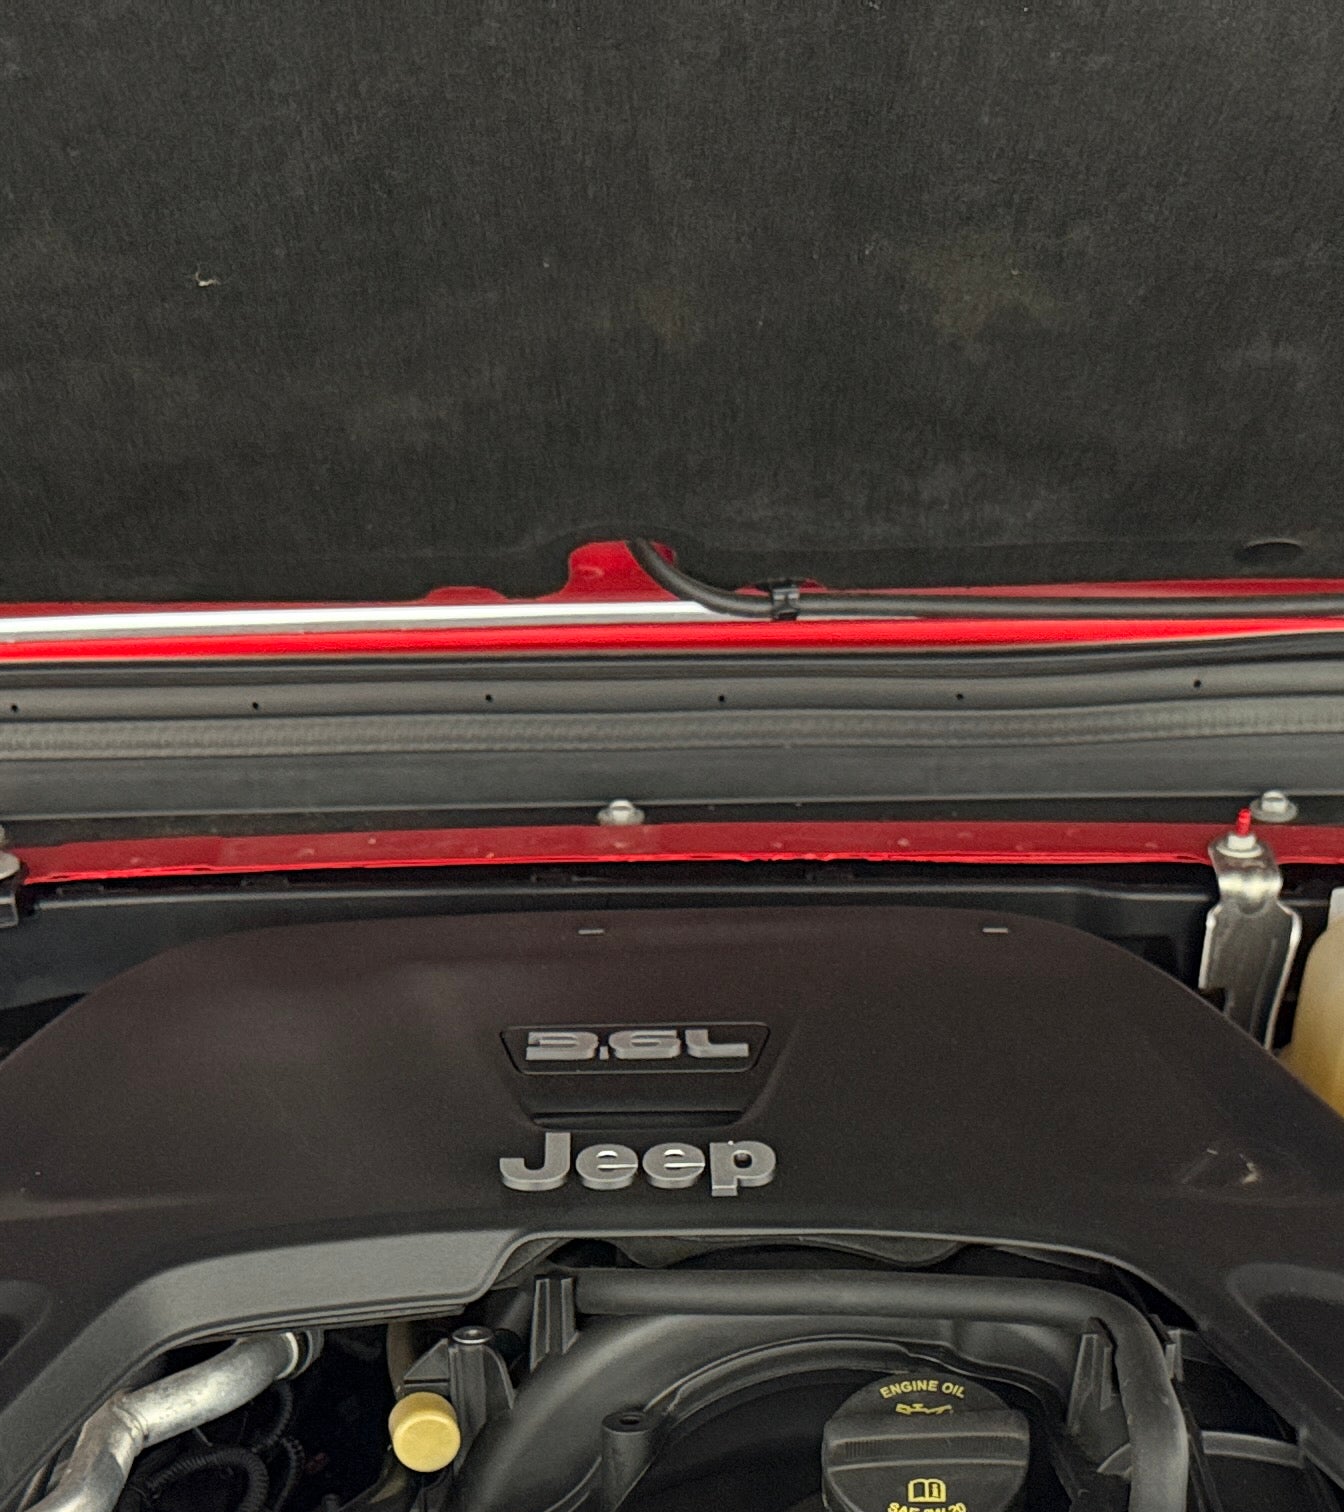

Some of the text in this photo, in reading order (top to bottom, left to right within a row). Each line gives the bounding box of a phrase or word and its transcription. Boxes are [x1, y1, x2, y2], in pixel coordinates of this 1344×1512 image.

[526, 1029, 749, 1061] 3.6L
[499, 1132, 777, 1197] Jeep
[879, 1379, 966, 1399] ENGINE OIL
